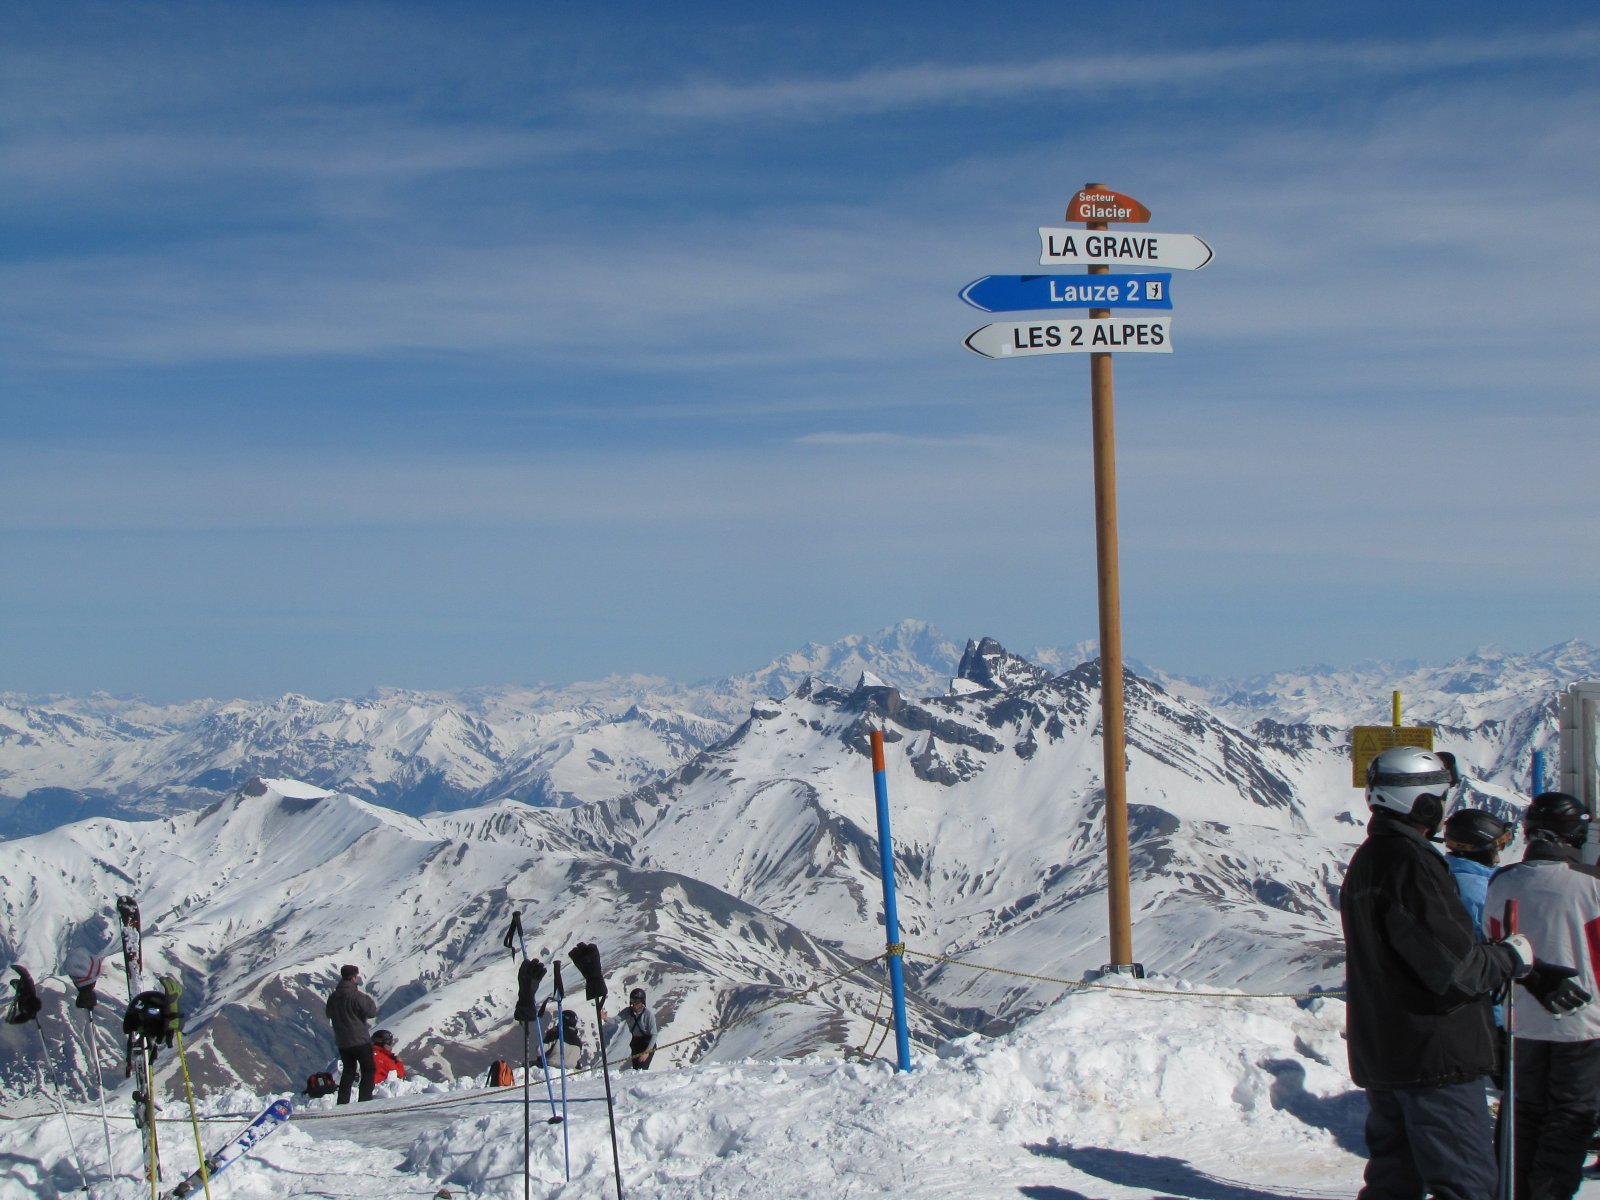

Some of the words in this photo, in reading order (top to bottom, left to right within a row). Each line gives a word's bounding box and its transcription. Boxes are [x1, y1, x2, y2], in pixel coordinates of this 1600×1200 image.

[1079, 192, 1115, 202] Secteur
[1079, 204, 1132, 218] Glacier
[1048, 235, 1078, 257] LA
[1085, 236, 1159, 260] GRAVE
[1050, 280, 1119, 302] Lauze
[1126, 280, 1140, 301] 2
[1014, 325, 1062, 349] LES
[1070, 325, 1084, 346] 2
[1092, 323, 1164, 346] ALPES
